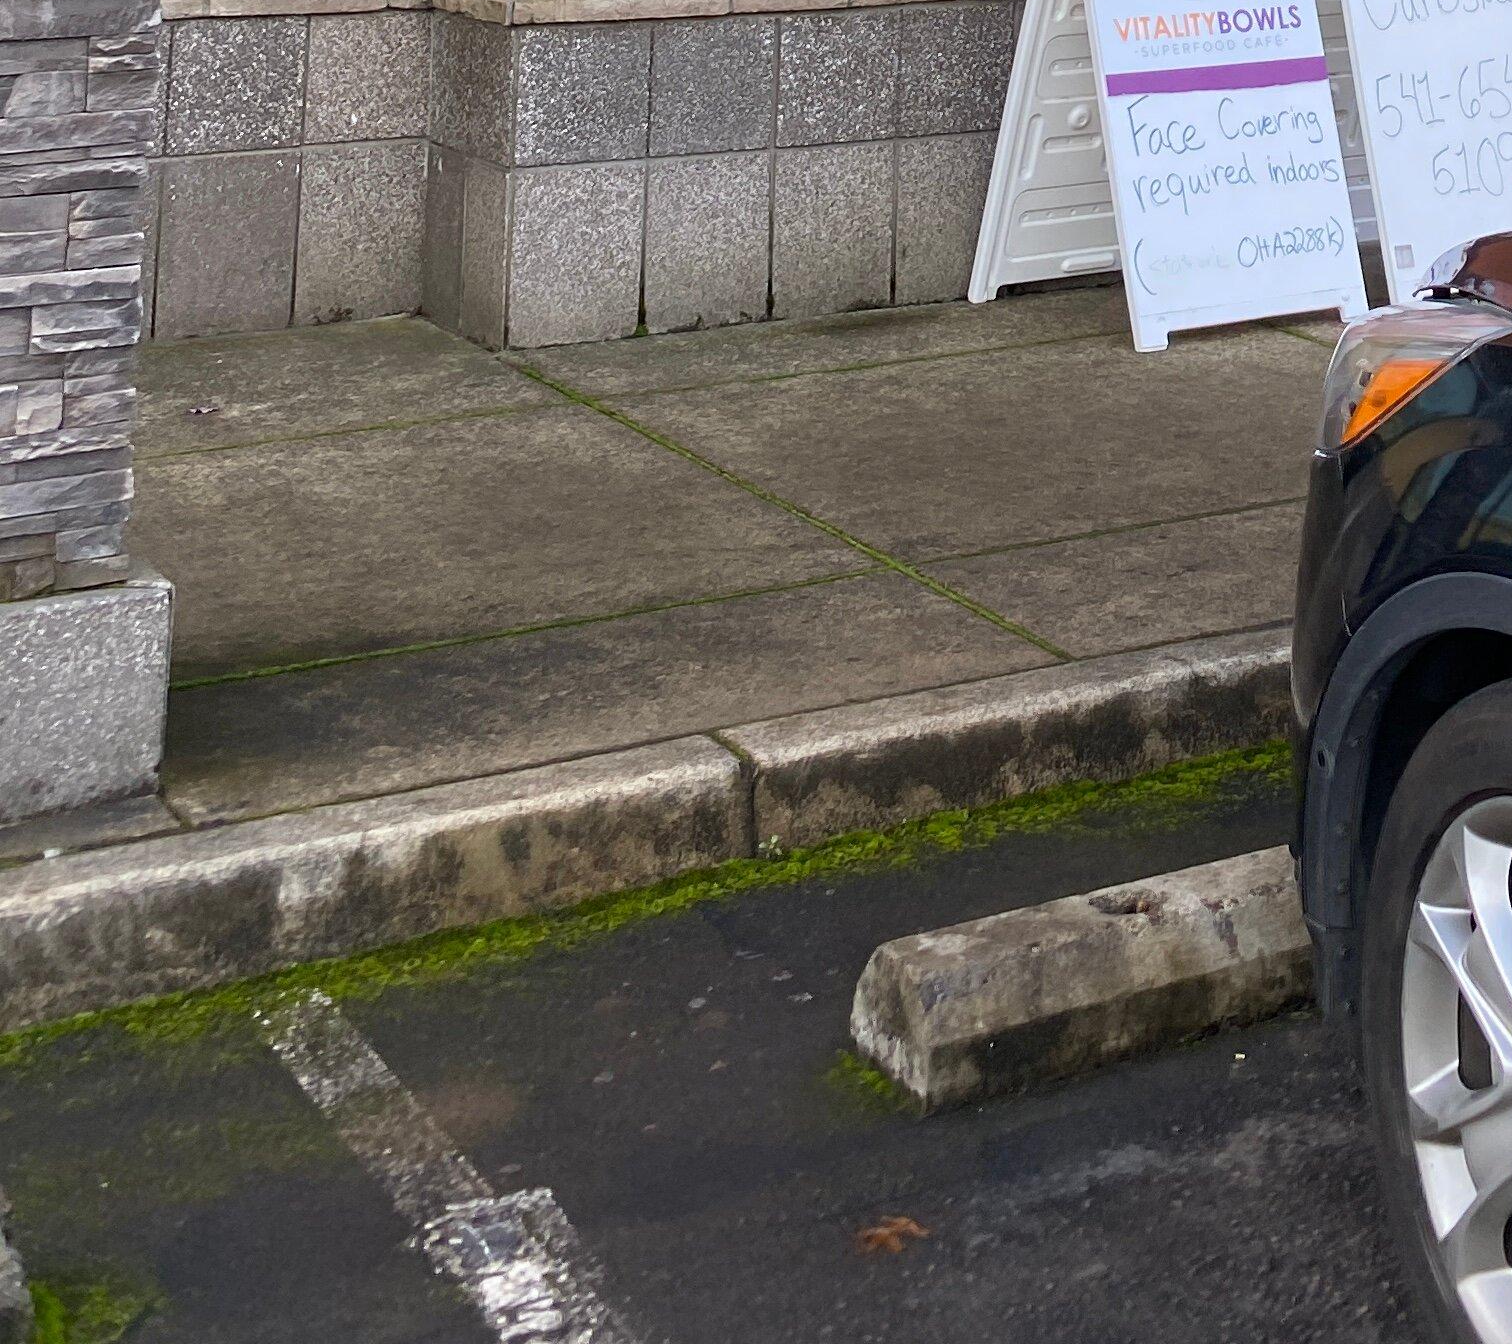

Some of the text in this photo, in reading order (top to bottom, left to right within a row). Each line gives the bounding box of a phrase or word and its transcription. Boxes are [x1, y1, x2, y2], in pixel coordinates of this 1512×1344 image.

[1127, 95, 1323, 156] Face Covering
[1133, 151, 1340, 216] required indoors
